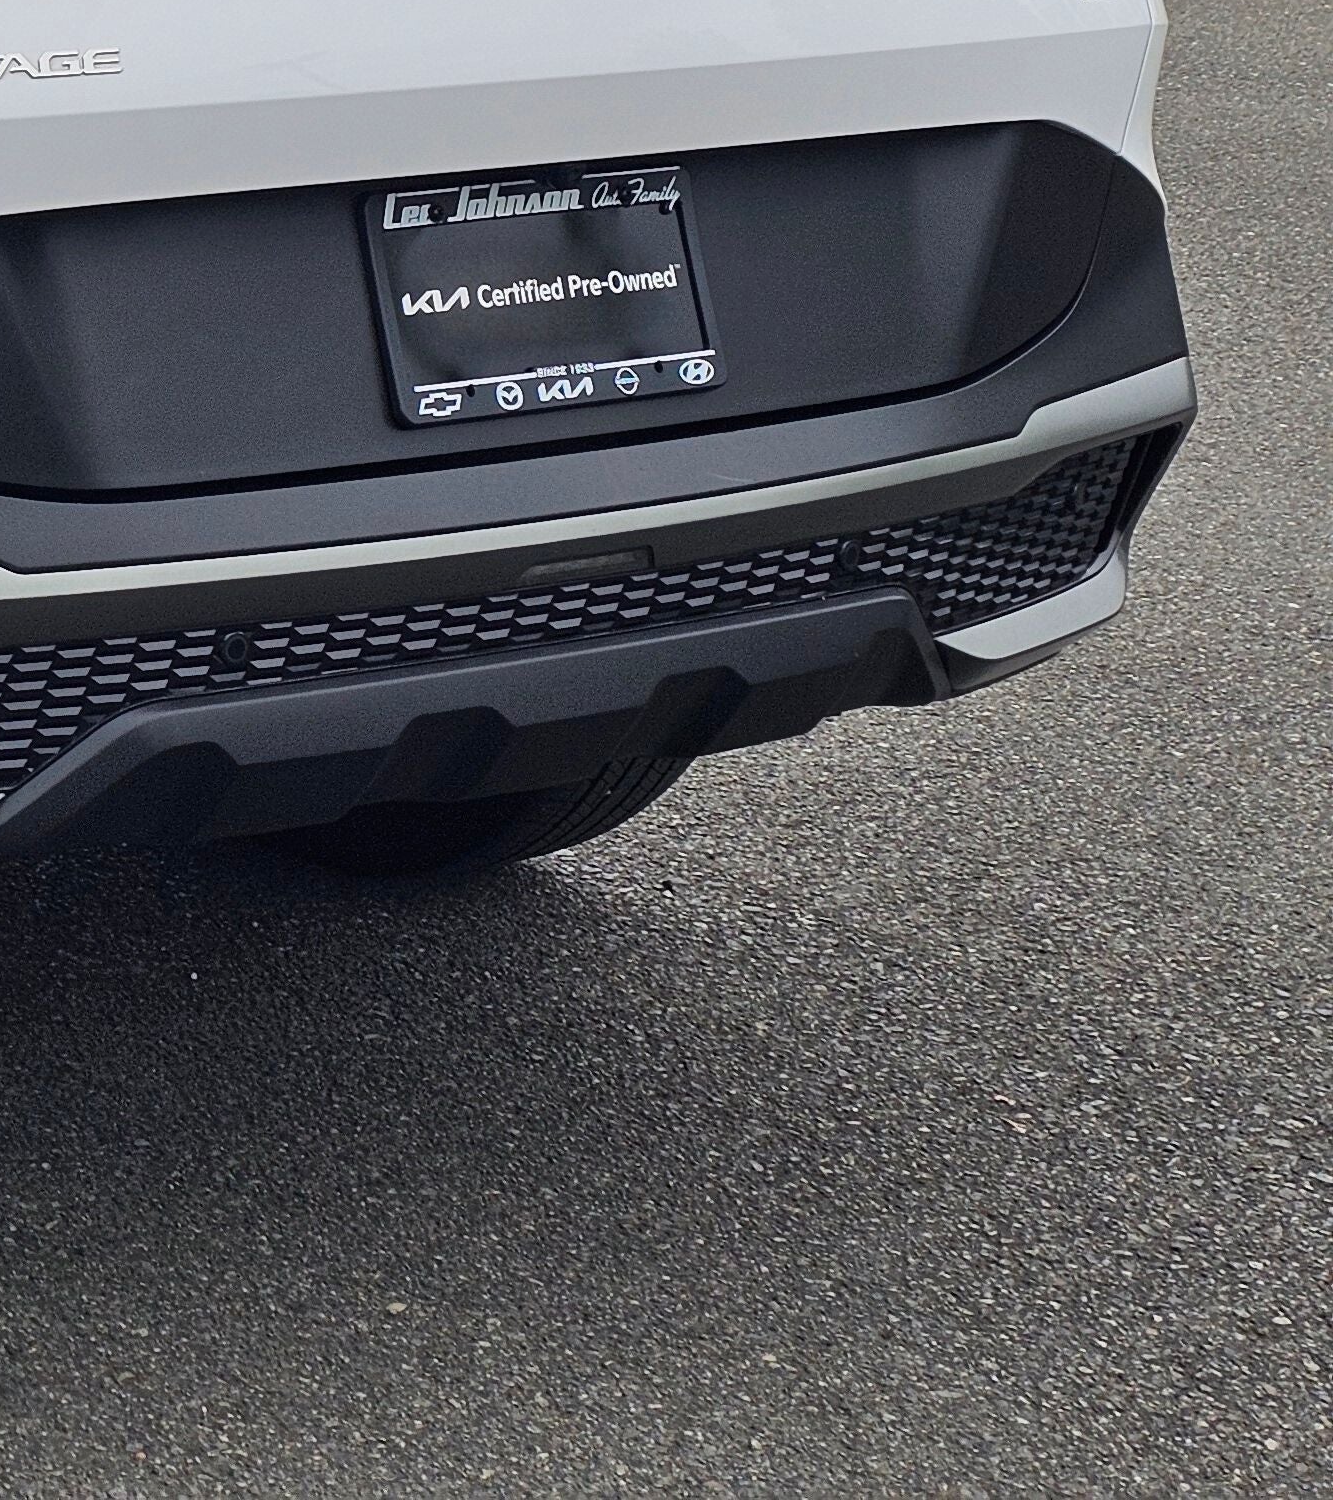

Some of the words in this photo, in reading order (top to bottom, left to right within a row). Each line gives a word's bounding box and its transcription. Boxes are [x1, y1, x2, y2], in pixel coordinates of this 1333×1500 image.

[447, 182, 584, 222] Johnson
[627, 175, 681, 211] Family
[401, 286, 470, 316] KIA
[476, 275, 564, 309] Certified
[536, 364, 568, 379] SINCE
[537, 376, 594, 402] KIA
